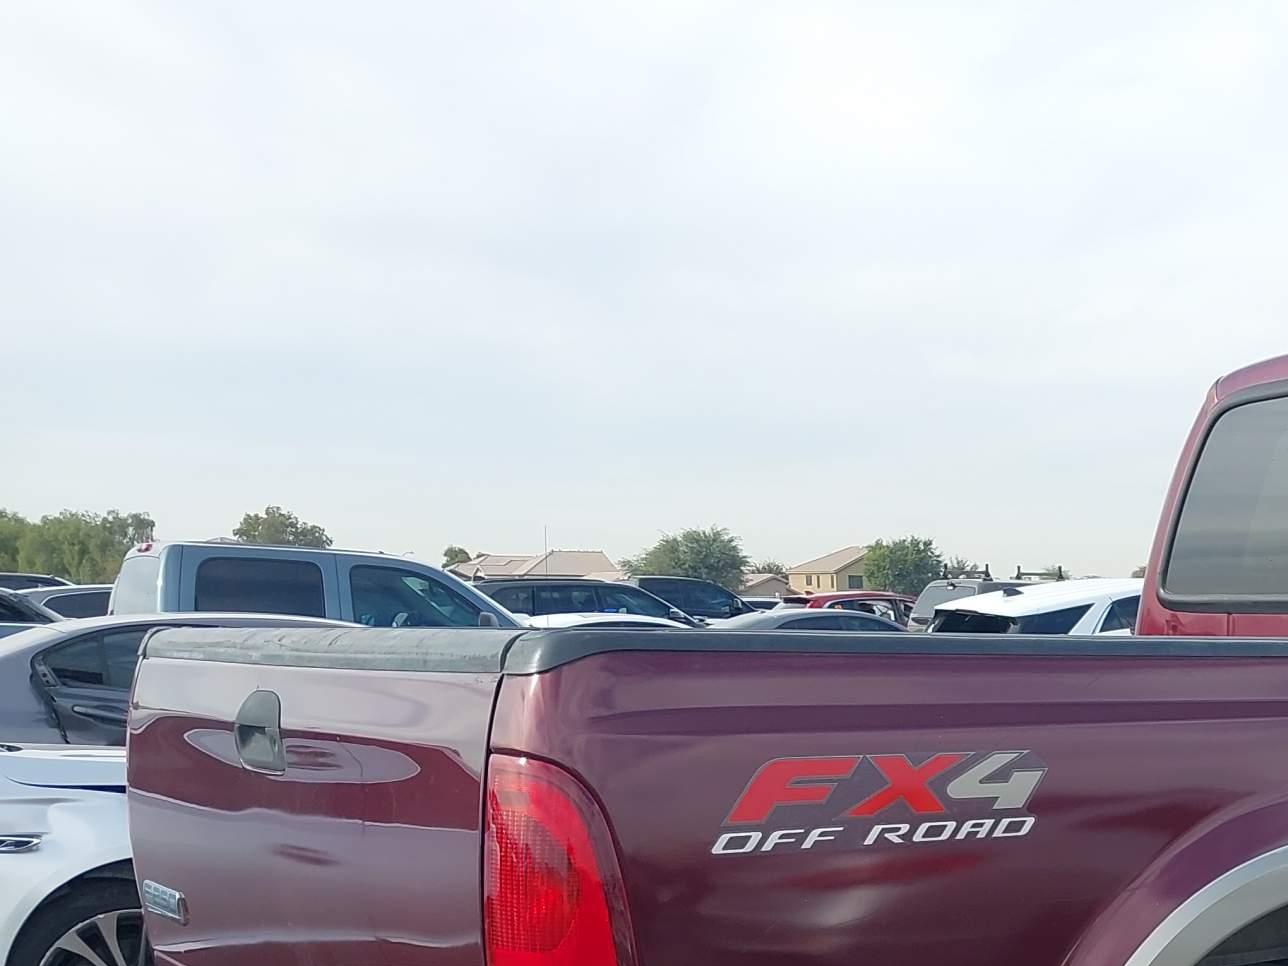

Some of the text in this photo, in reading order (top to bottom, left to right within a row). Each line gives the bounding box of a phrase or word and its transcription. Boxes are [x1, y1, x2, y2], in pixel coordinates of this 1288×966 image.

[723, 750, 1047, 825] FX4
[712, 816, 1036, 854] OFF ROAD
